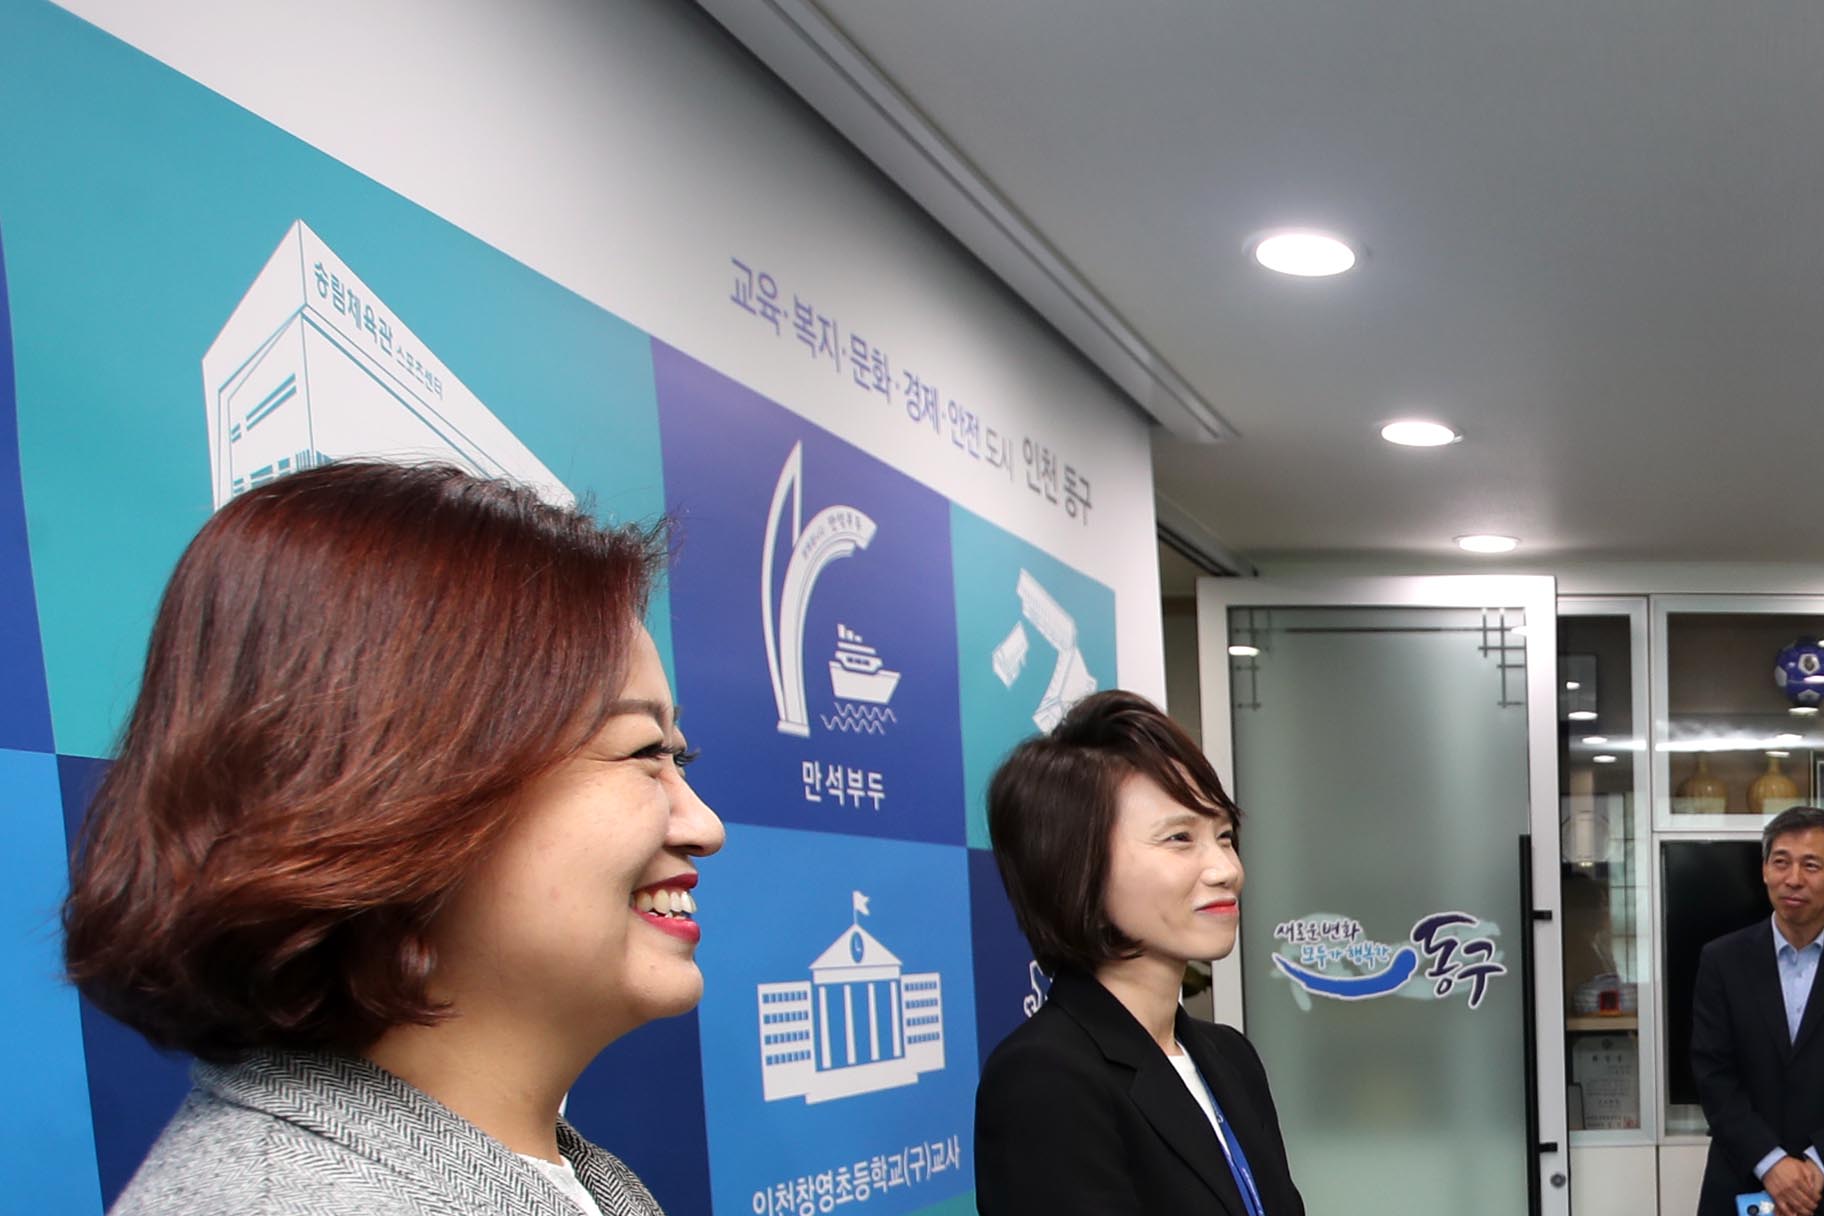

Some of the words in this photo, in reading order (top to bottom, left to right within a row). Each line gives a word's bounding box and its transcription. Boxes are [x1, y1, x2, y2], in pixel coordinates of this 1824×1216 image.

[314, 261, 393, 358] 송림체육관
[985, 428, 1014, 482] 도시
[1022, 436, 1058, 505] 인천
[1064, 464, 1093, 526] 동구
[802, 760, 886, 812] 만석부두
[1275, 921, 1320, 942] 새로운
[1322, 920, 1360, 942] 변화
[1302, 945, 1343, 968] 모두가
[1347, 943, 1390, 968] 행복한
[1412, 914, 1504, 1007] 동구
